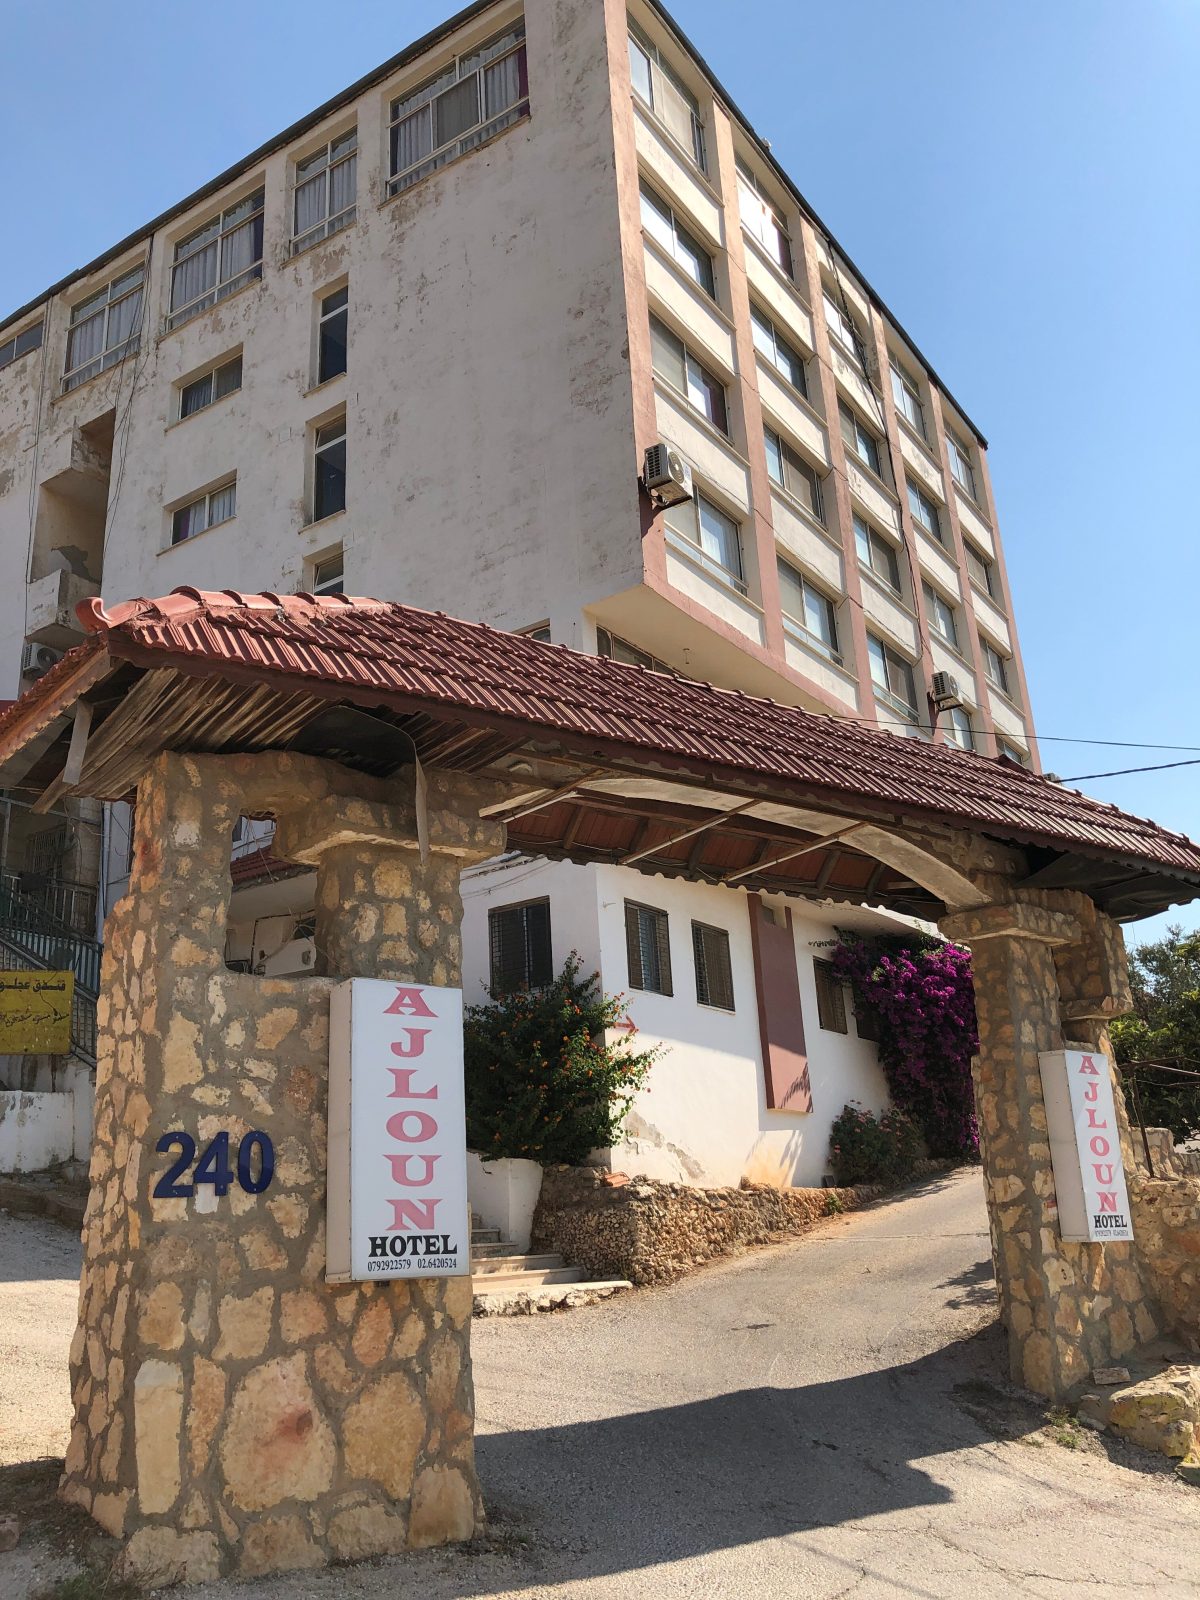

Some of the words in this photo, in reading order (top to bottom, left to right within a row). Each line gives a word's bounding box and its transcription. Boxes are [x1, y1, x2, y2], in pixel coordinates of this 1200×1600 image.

[382, 986, 443, 1231] AJLOUN
[1078, 1055, 1118, 1213] AJLOUN
[153, 1130, 275, 1198] 240
[1093, 1215, 1128, 1229] HOTEL
[367, 1234, 458, 1257] HOTEL
[367, 1258, 412, 1272] 0792922579
[417, 1258, 457, 1269] 02.6420524
